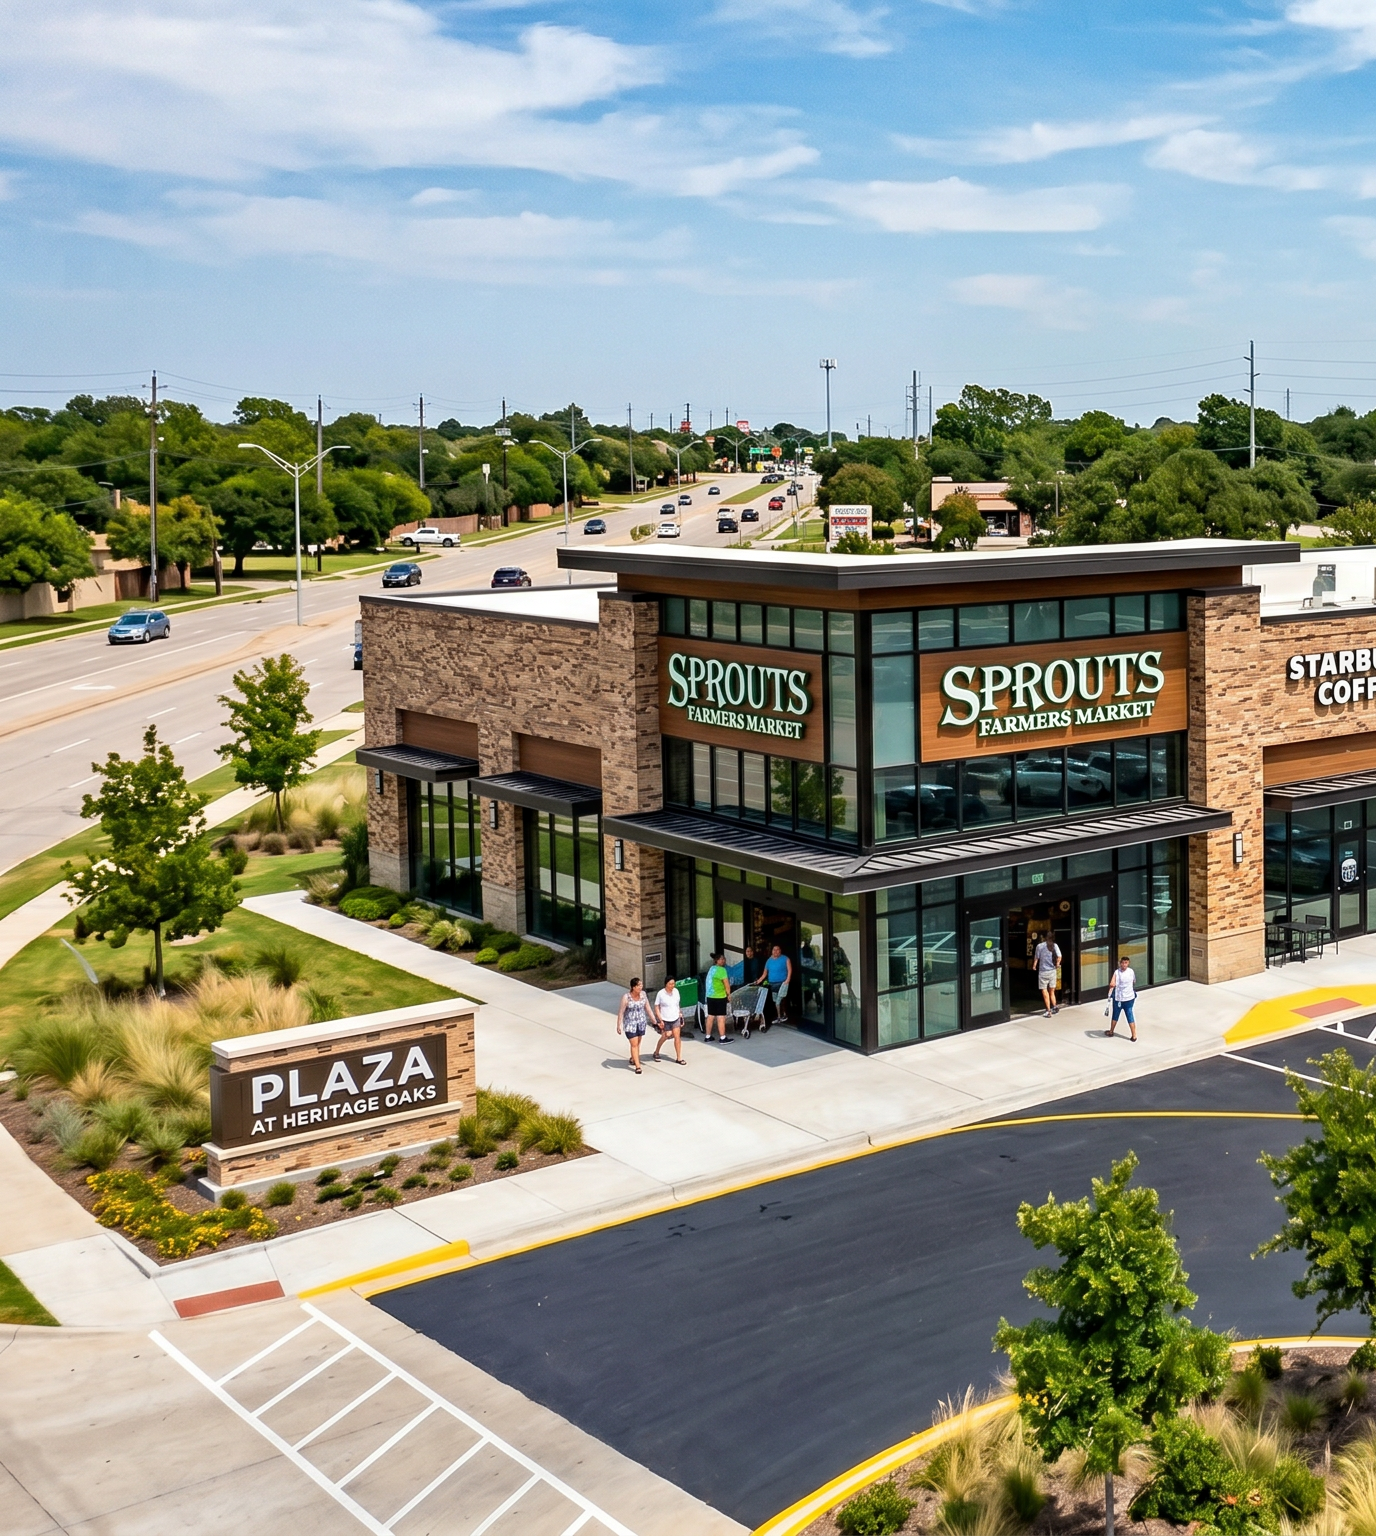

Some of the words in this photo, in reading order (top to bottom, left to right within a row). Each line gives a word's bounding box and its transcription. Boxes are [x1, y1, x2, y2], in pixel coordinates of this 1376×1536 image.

[667, 653, 808, 715] SPROUTS
[940, 651, 1165, 726] SPROUTS
[687, 705, 745, 730] FARMERS
[746, 714, 803, 739] MARKET
[978, 710, 1072, 737] FARMERS
[1074, 700, 1156, 725] MARKET
[251, 1045, 435, 1115] PLAZA
[250, 1117, 278, 1136] AT
[282, 1097, 380, 1129] HERITAGE
[385, 1084, 437, 1108] OAKS
